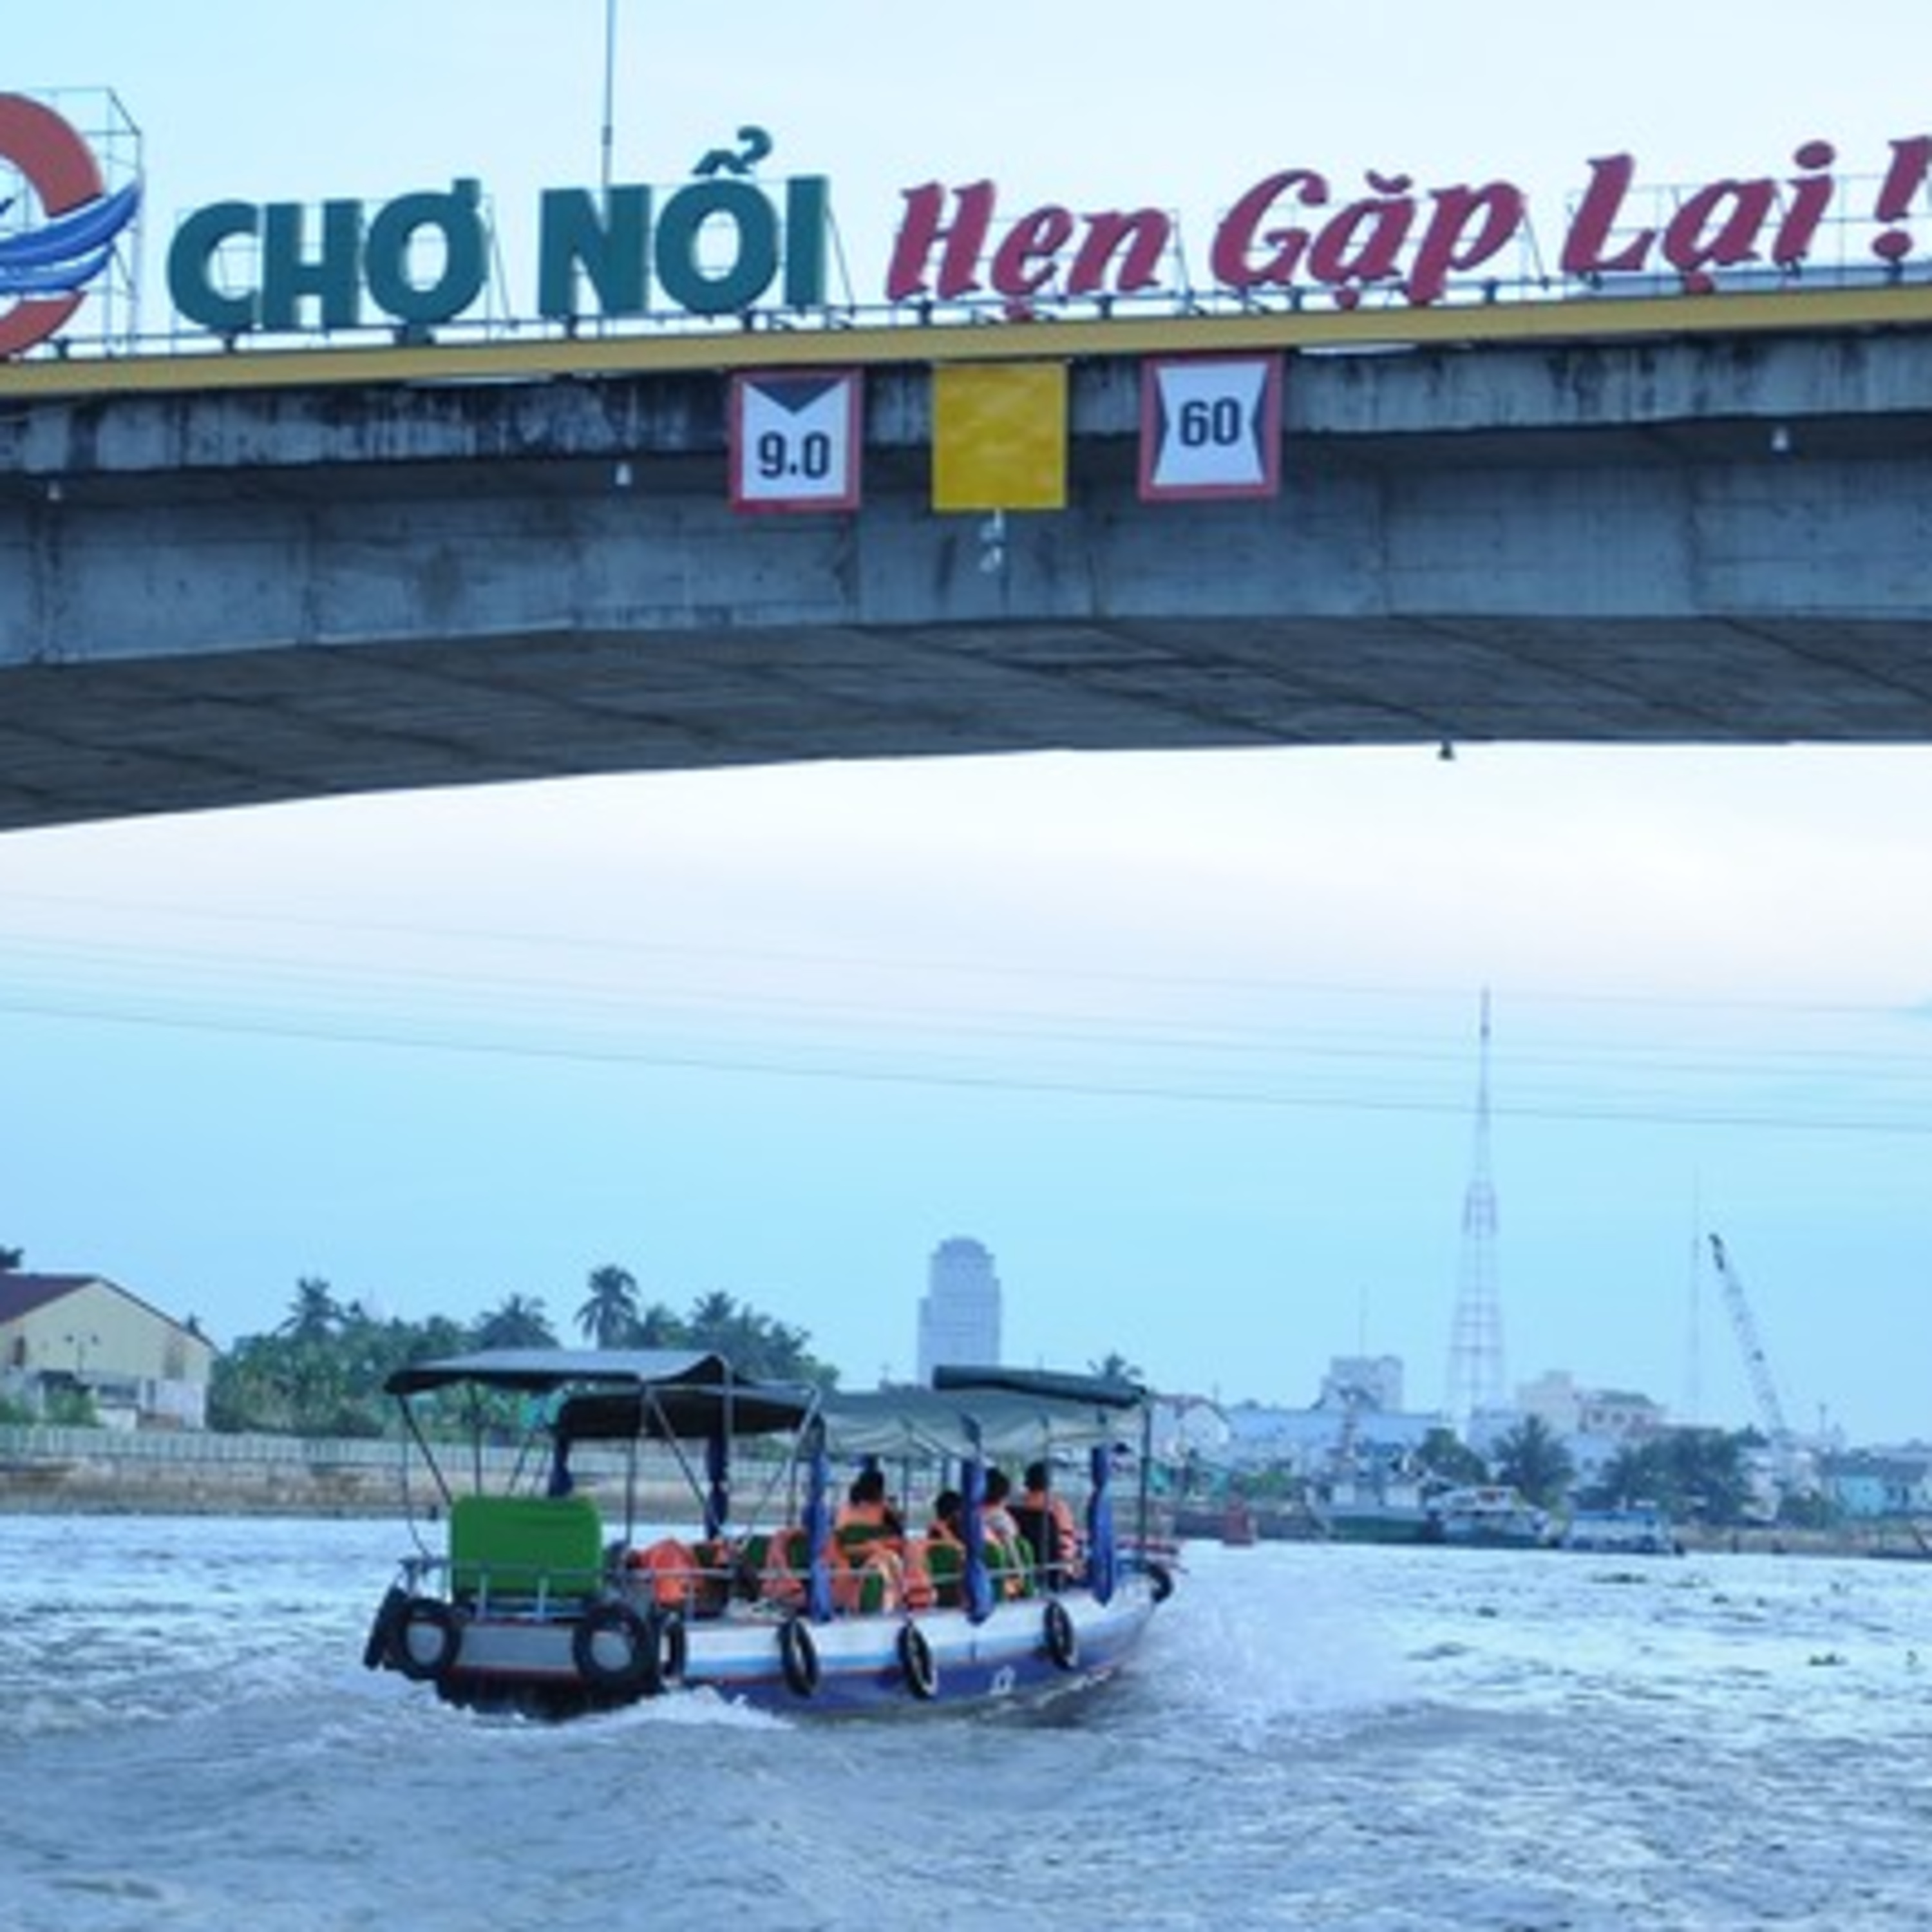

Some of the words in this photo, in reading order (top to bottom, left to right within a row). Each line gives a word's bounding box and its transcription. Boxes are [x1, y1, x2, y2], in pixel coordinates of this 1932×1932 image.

[167, 178, 488, 343] CHỢ
[538, 126, 828, 315] NỔI
[886, 180, 1173, 321] Hẹn
[1209, 169, 1526, 305] Gặp
[1179, 397, 1242, 446] 60
[757, 431, 831, 479] 9.0
